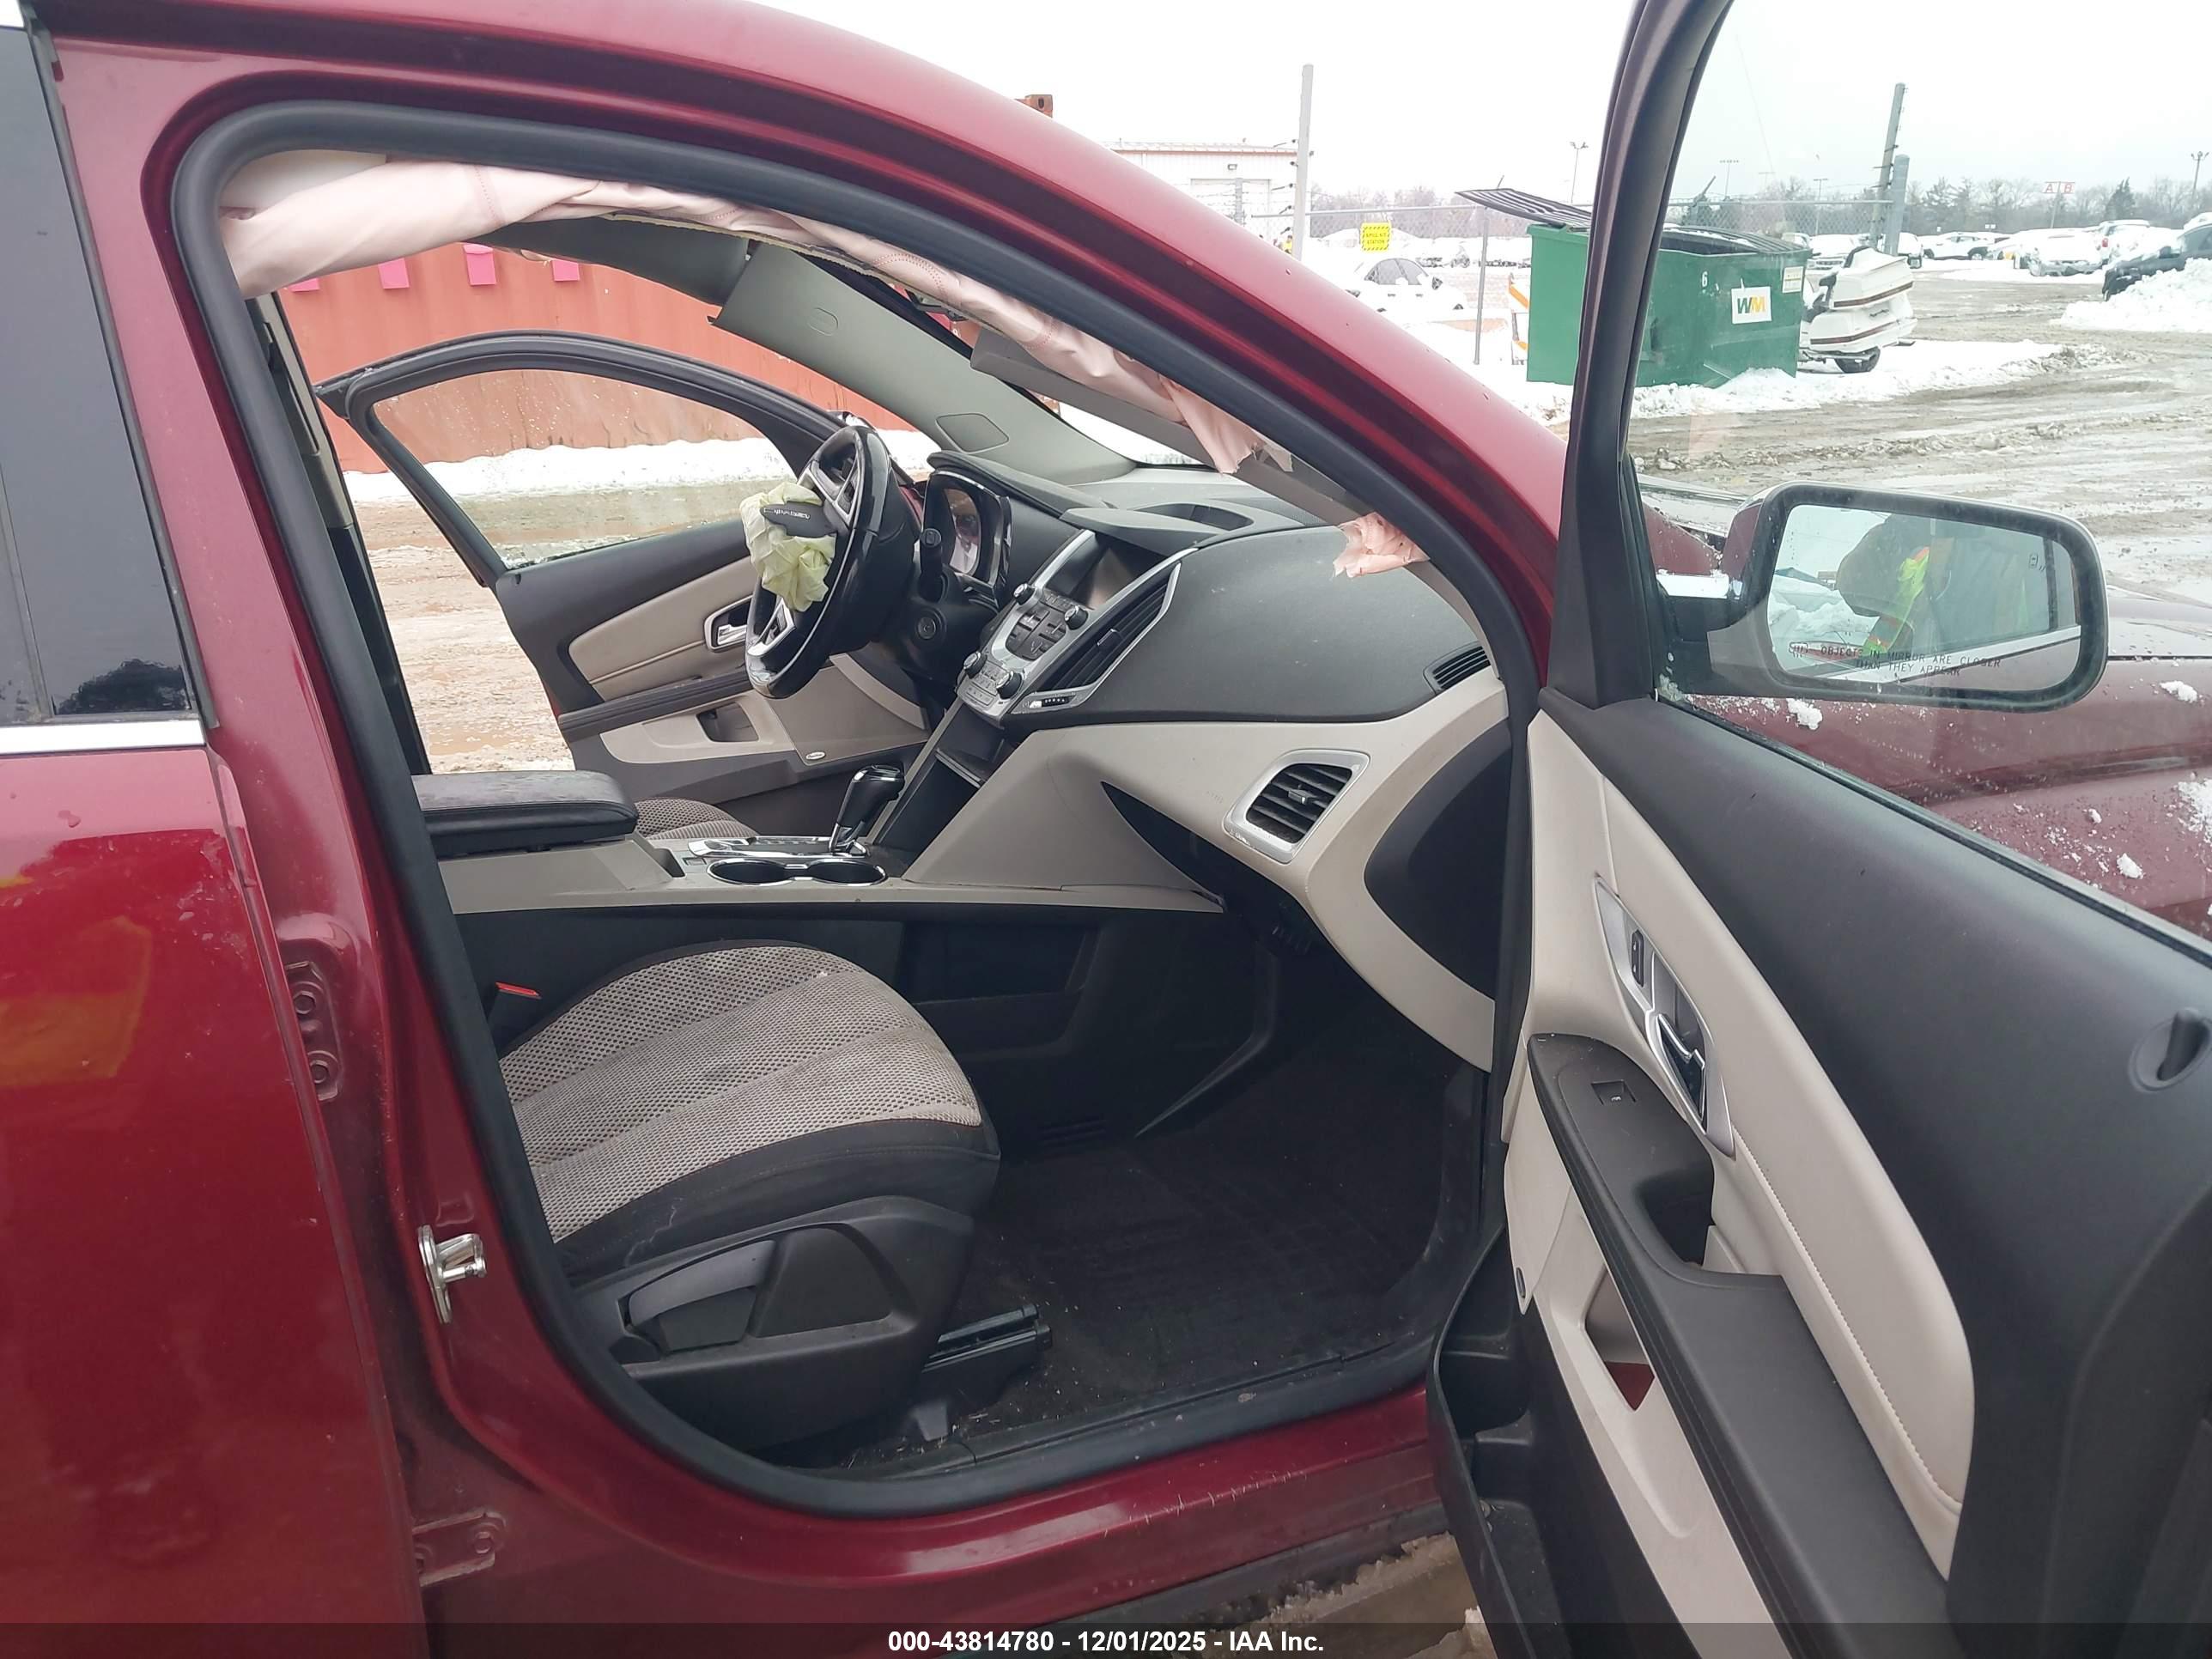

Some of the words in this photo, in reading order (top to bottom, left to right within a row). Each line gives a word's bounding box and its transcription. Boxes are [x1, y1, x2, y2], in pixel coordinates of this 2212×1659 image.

[1702, 271, 1708, 287] 6
[1736, 296, 1766, 314] WM
[1820, 646, 1863, 657] OBJECTS
[1870, 650, 1880, 659] IN
[1887, 652, 1925, 662] MIRROR
[1932, 655, 1952, 665] ARE
[1960, 656, 2001, 668] CLOSER
[1856, 659, 1881, 670] THAN
[1888, 662, 1914, 672] THEY
[1920, 665, 1960, 676] APPEAR
